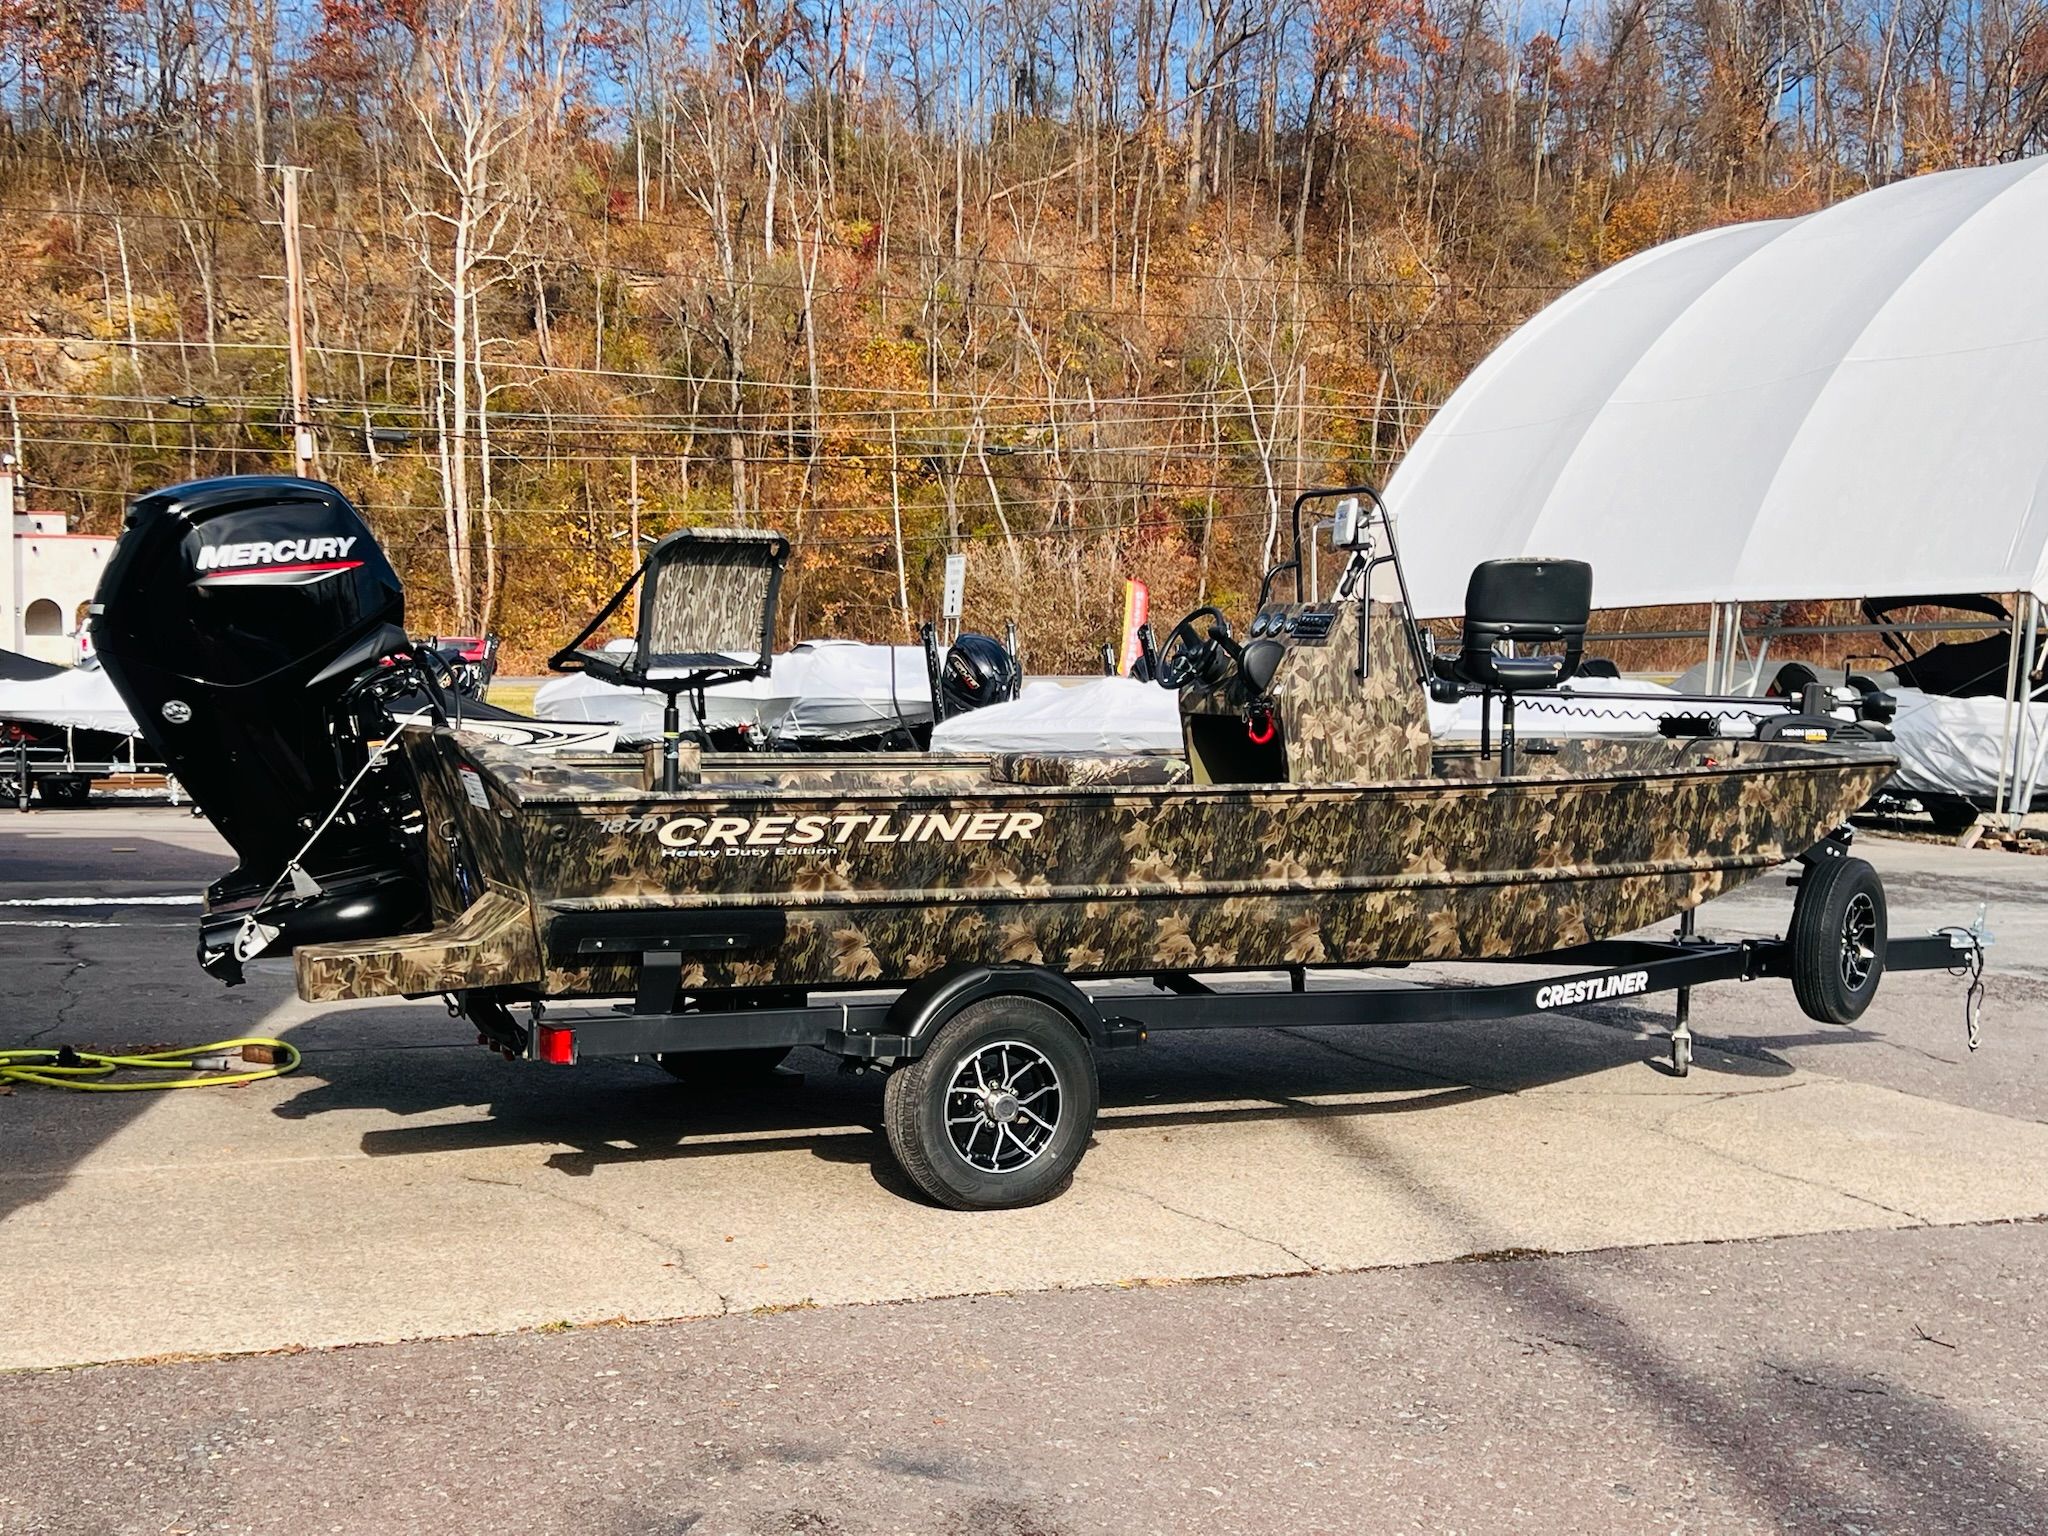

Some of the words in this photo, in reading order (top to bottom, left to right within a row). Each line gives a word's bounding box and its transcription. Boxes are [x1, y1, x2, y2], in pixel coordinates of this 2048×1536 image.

[196, 536, 357, 570] MERCURY
[600, 819, 658, 834] 1870
[658, 813, 1043, 847] CRESTLINER
[661, 848, 721, 858] Heavy
[725, 847, 771, 857] Duty
[774, 846, 838, 856] Edition
[1536, 971, 1648, 1009] CRESTLINER
